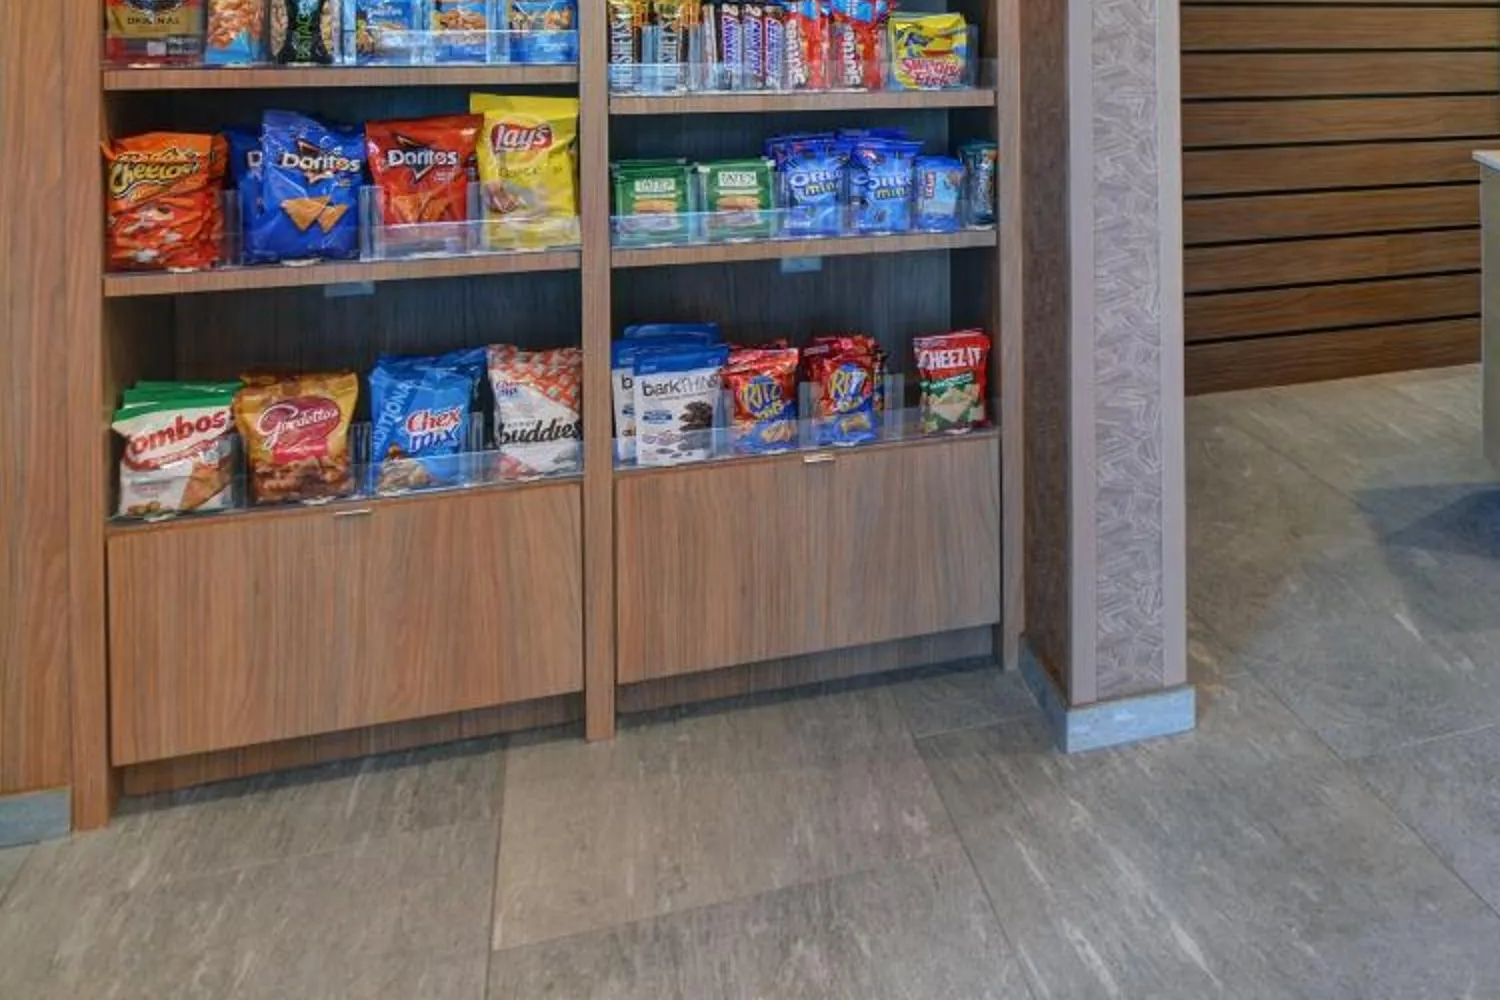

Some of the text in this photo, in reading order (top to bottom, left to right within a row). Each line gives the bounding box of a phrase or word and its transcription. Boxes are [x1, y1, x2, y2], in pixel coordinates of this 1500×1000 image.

[280, 150, 361, 173] Doritos
[386, 148, 460, 168] Doritos
[109, 160, 201, 195] Cheetos
[128, 411, 227, 456] ombos
[407, 407, 462, 434] Chex
[498, 418, 583, 446] buddies
